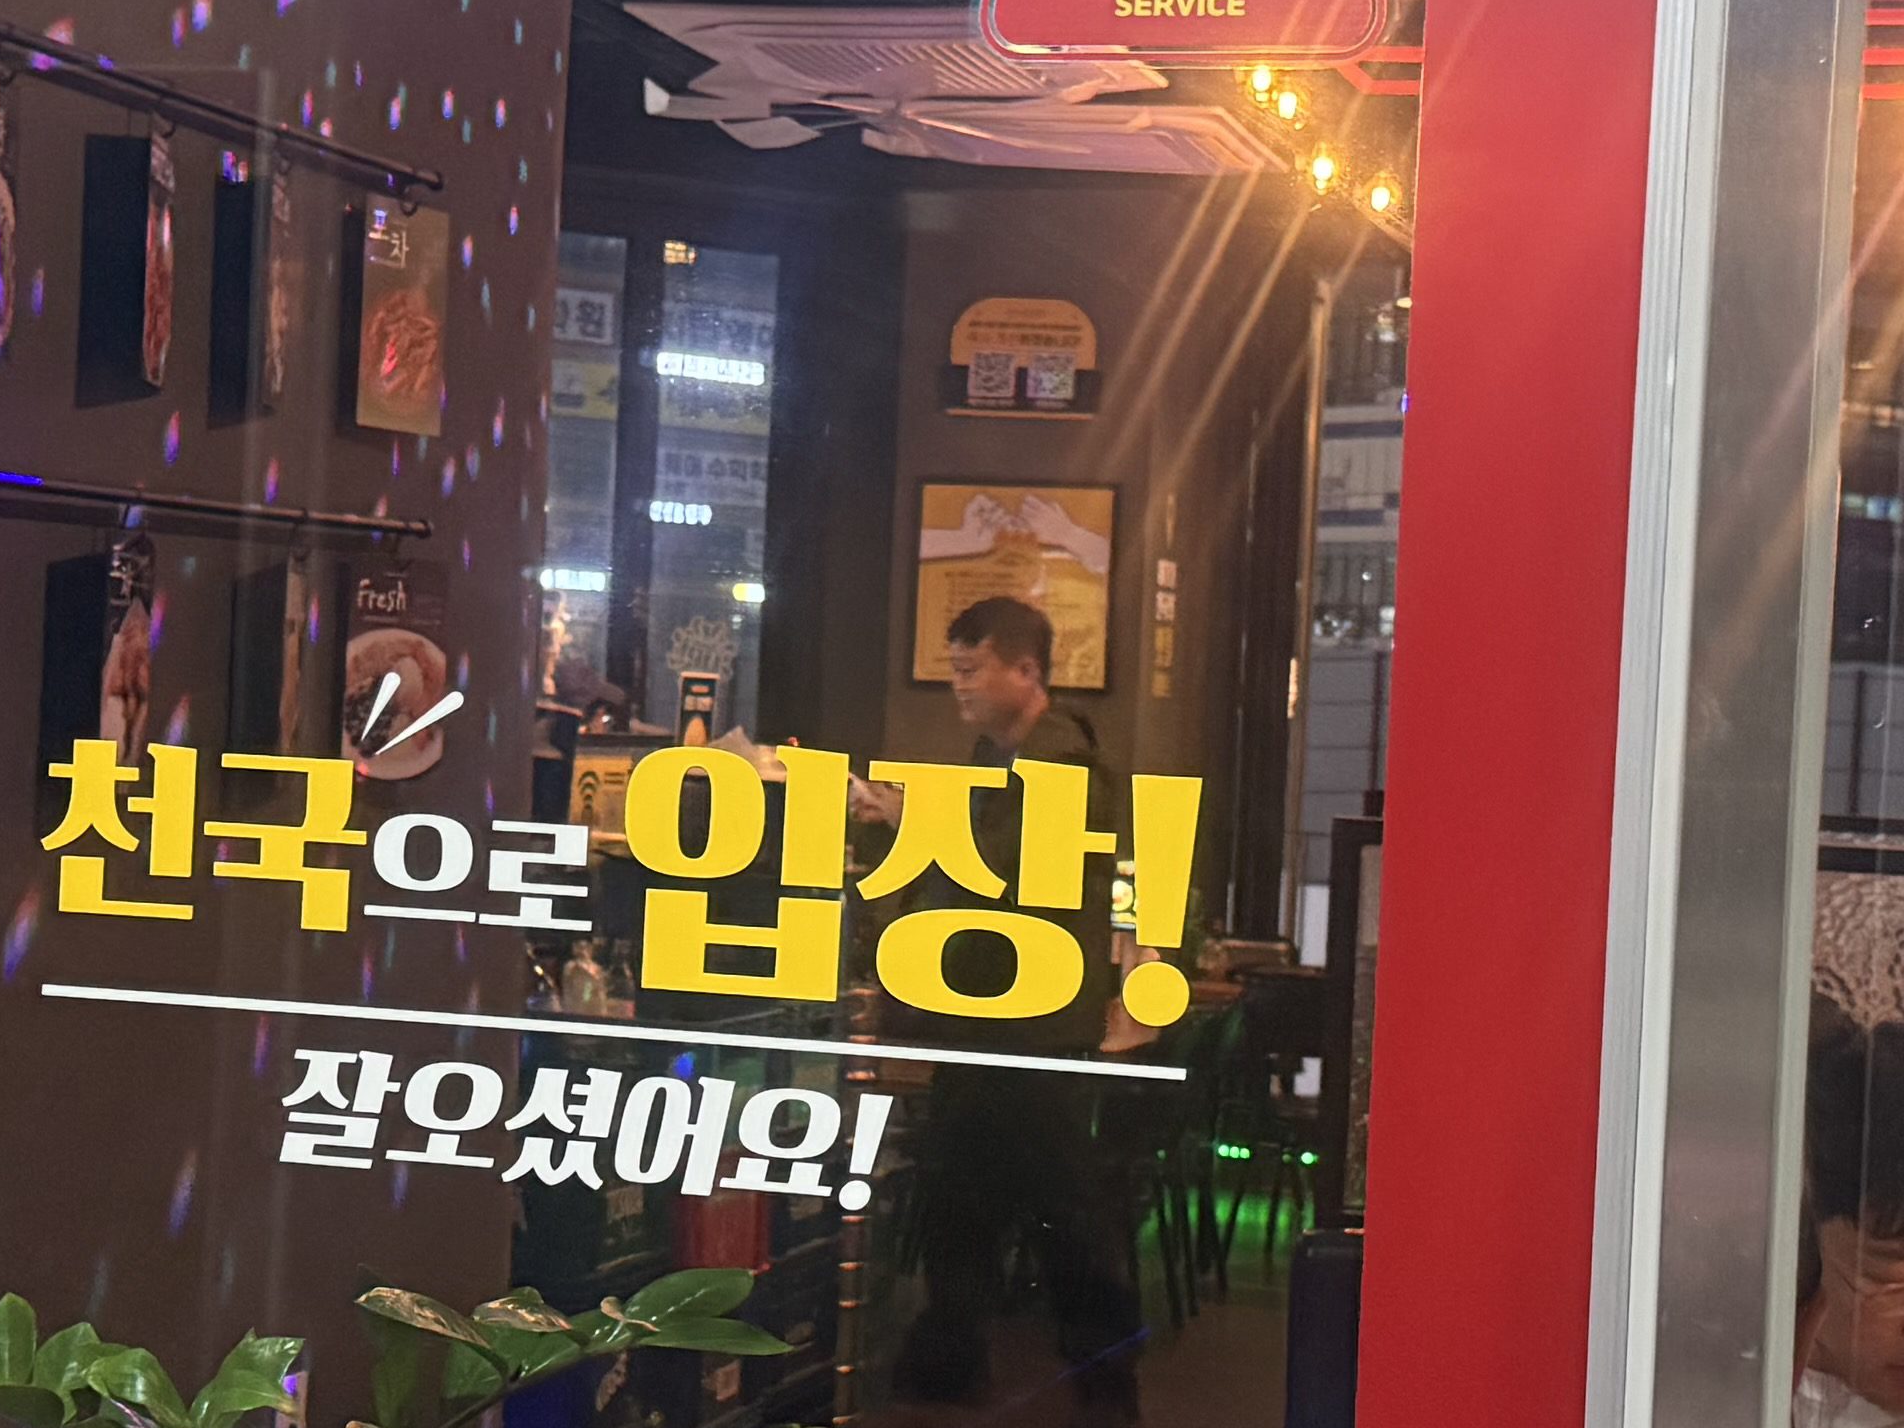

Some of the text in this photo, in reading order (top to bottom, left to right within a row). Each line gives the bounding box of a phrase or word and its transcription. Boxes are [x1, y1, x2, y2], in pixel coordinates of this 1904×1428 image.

[41, 738, 1203, 1028] 천국으로 입장!
[278, 1047, 893, 1213] 잘오셨어요!
